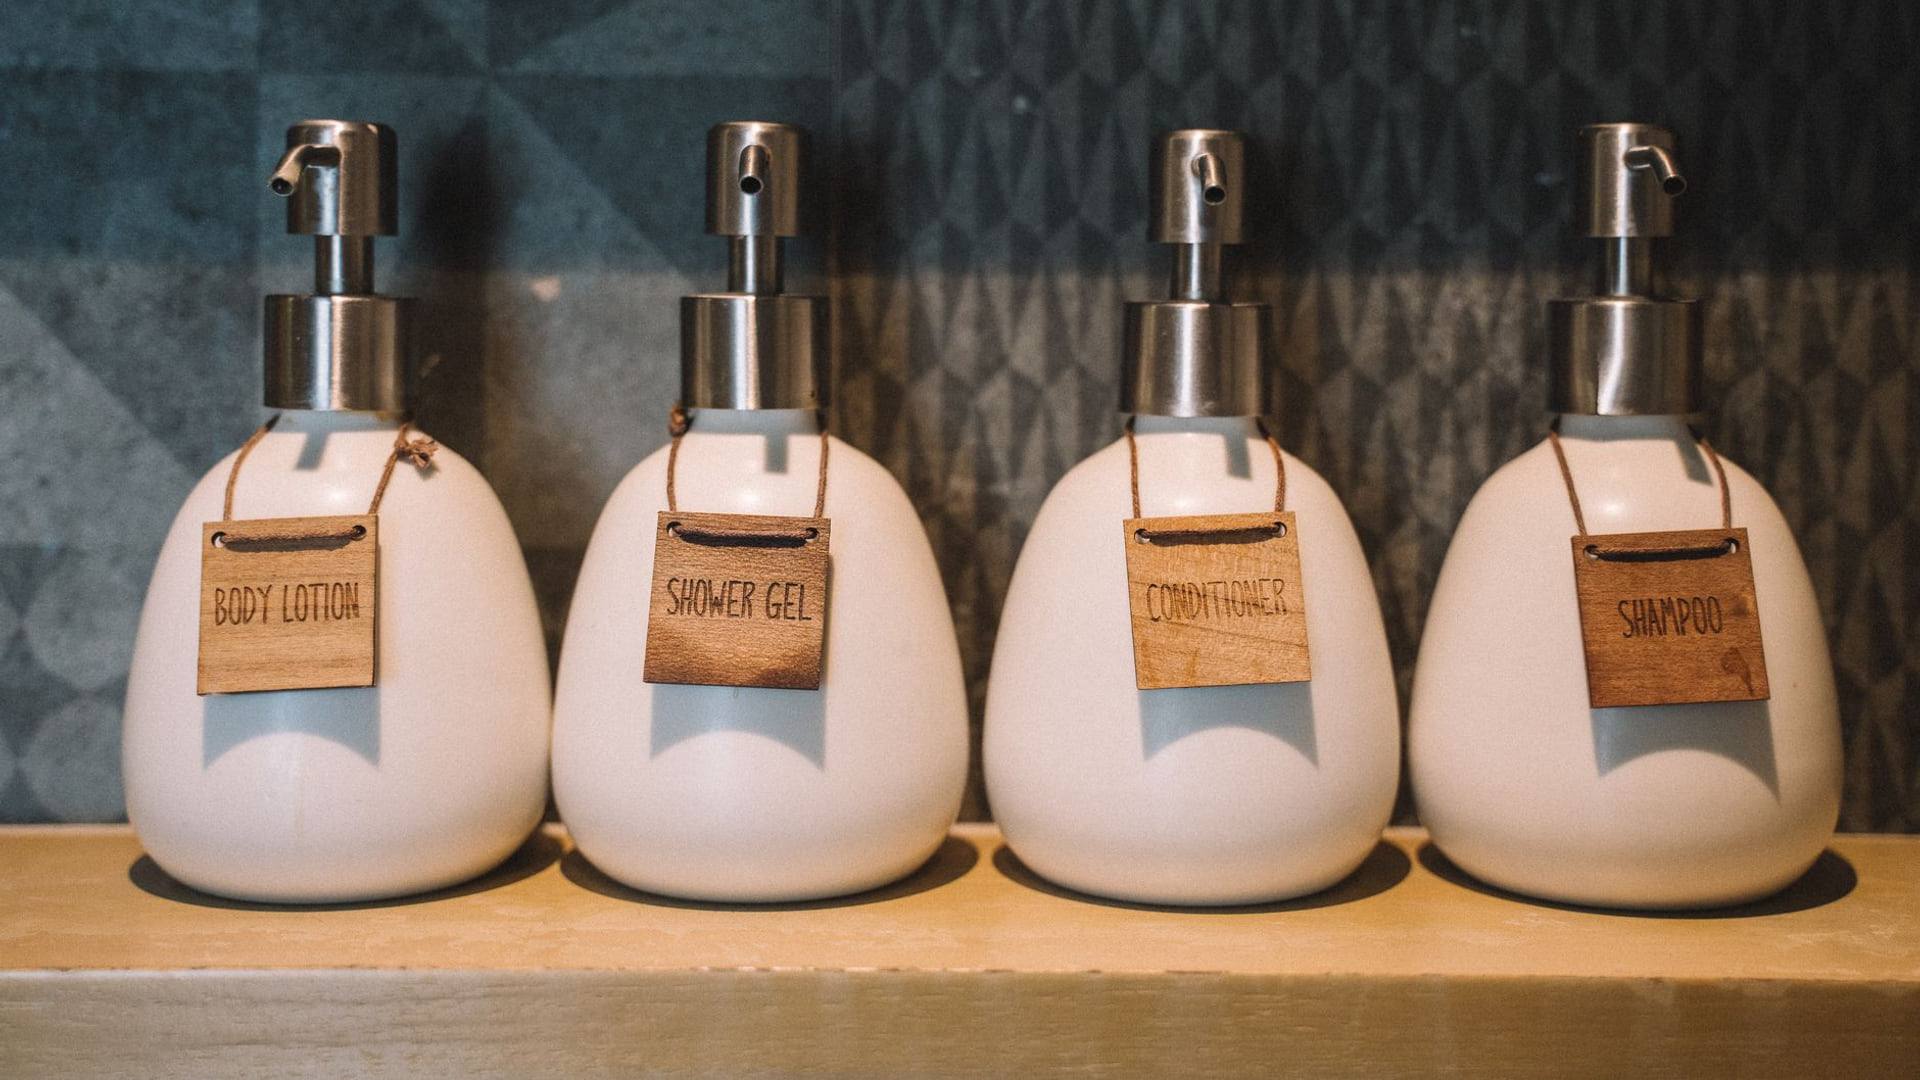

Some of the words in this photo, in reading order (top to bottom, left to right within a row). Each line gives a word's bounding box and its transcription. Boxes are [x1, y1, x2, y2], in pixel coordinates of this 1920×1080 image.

[215, 584, 272, 626] BODY
[283, 582, 360, 623] LOTION
[667, 577, 756, 619] SHOWER
[766, 582, 812, 621] GEL
[1146, 578, 1287, 622] CONDITIONER
[1617, 596, 1723, 638] SHAMPOO
